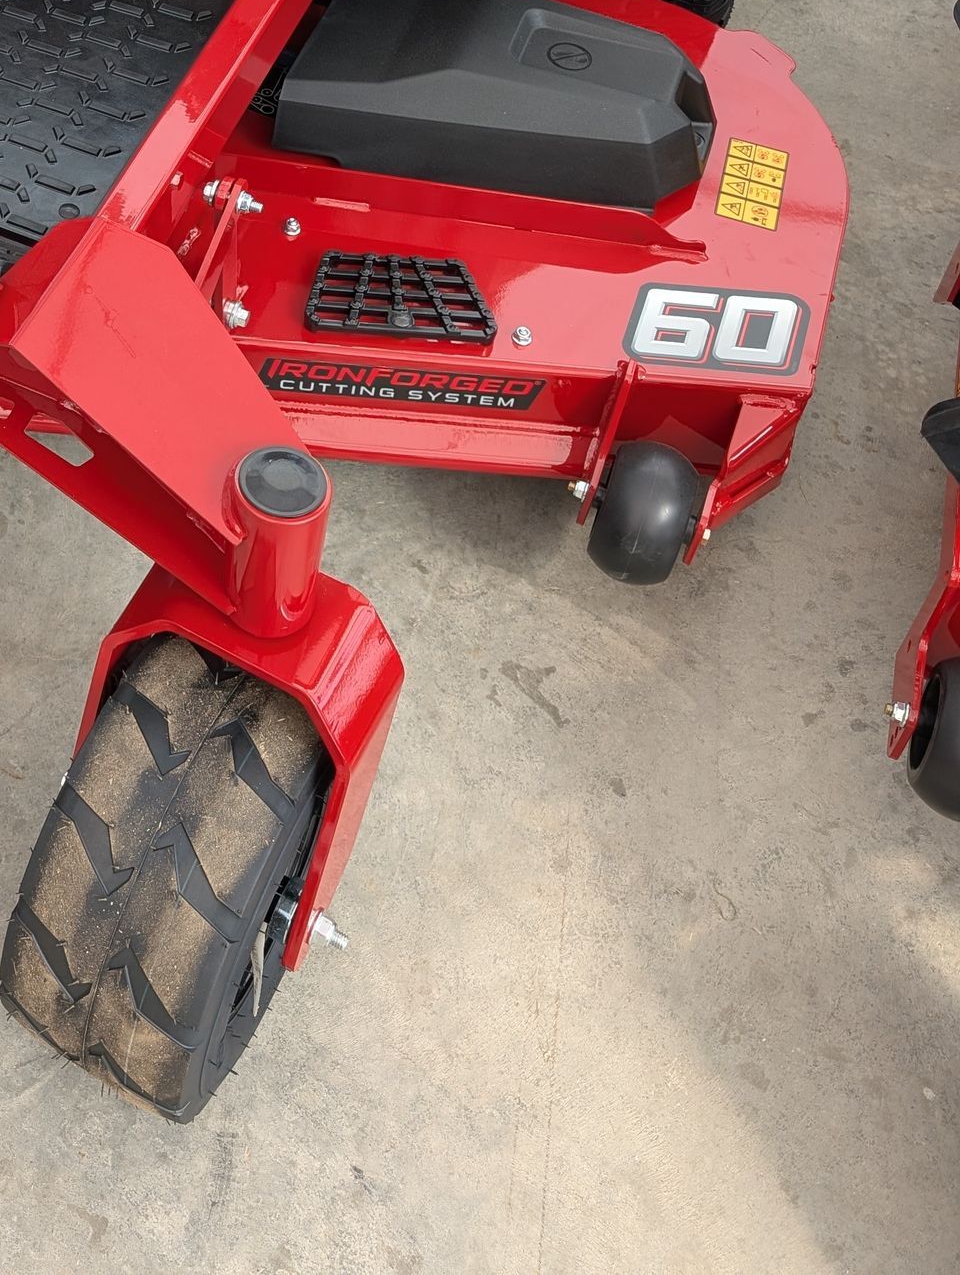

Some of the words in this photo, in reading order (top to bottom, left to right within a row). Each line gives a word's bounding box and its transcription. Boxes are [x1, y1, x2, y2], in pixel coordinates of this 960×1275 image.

[631, 288, 799, 367] 60
[267, 359, 534, 395] IRONFORGED
[279, 379, 395, 398] CUTTING
[407, 390, 515, 408] SYSTEM
